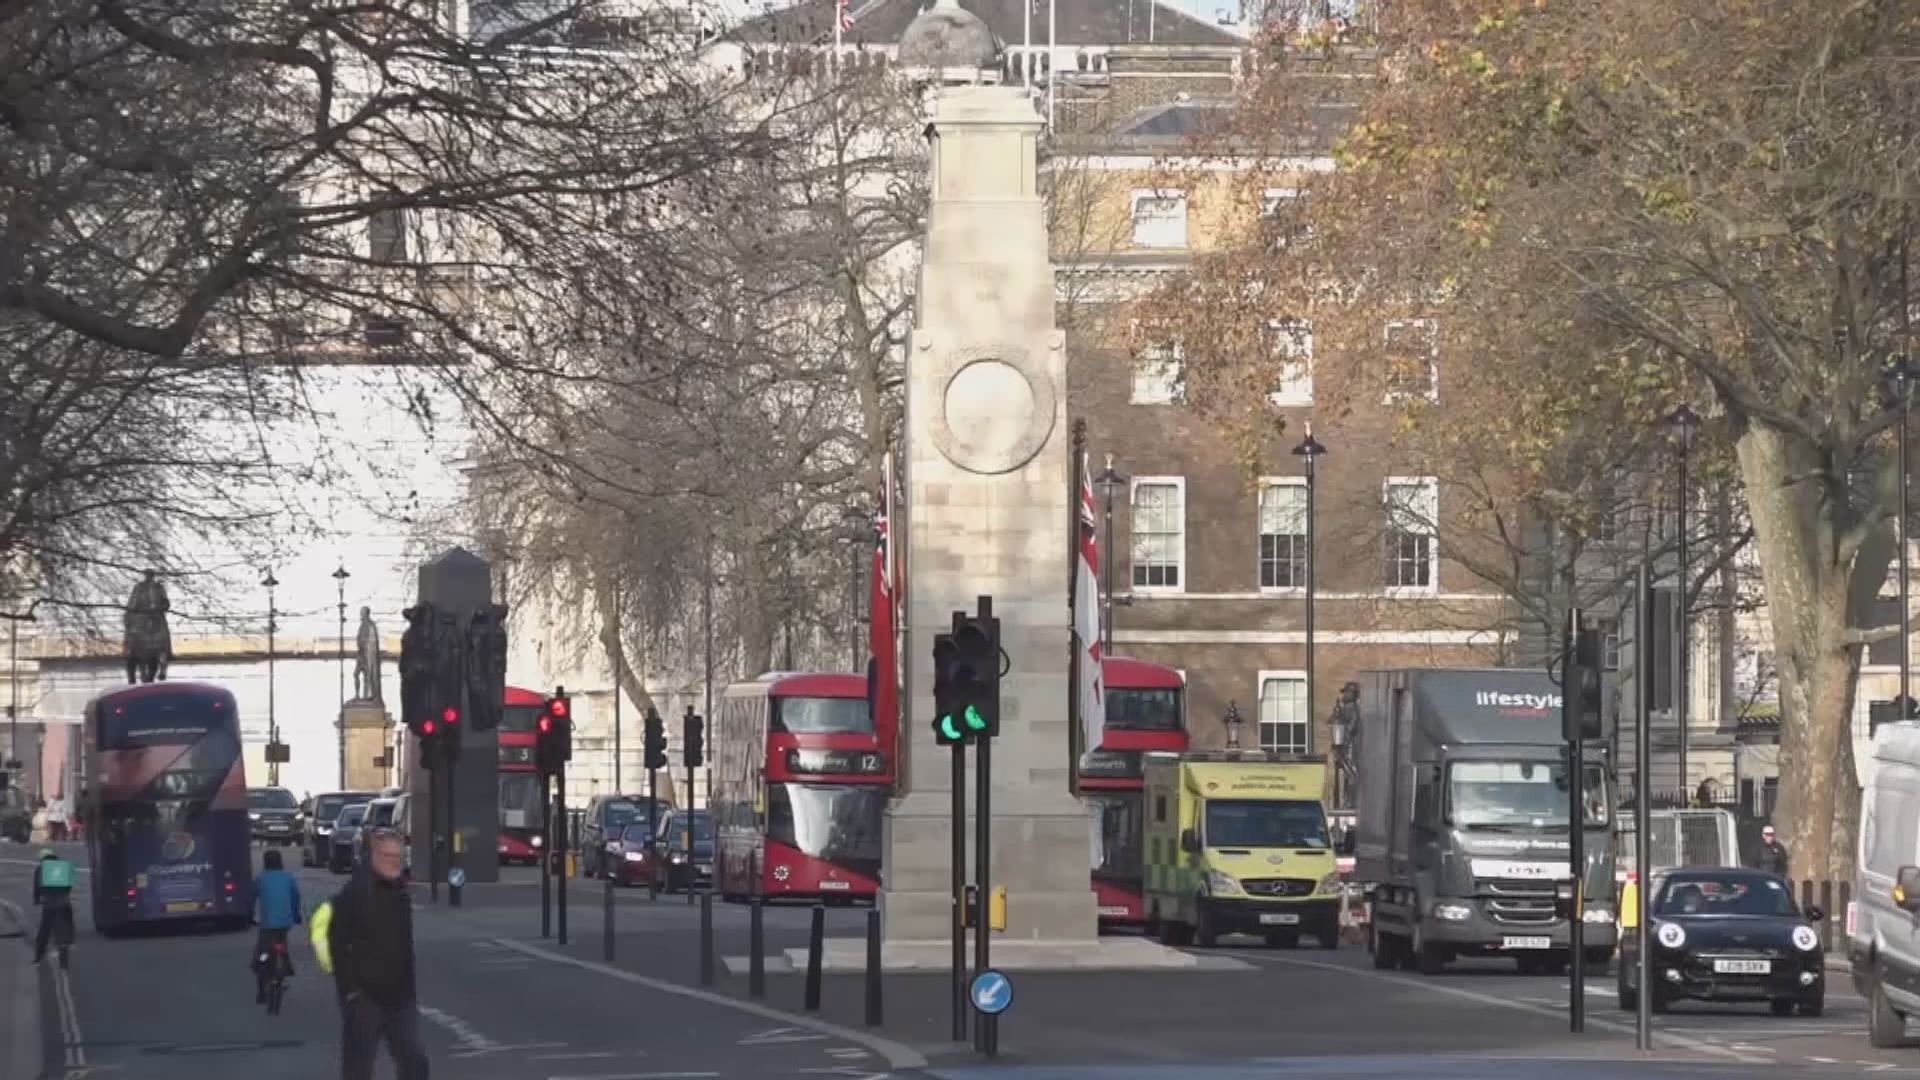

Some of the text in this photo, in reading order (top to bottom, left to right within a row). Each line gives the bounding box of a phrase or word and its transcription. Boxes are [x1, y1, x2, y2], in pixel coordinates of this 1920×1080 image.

[1476, 691, 1563, 709] lifestyle
[520, 747, 528, 761] 3
[861, 755, 877, 770] 12
